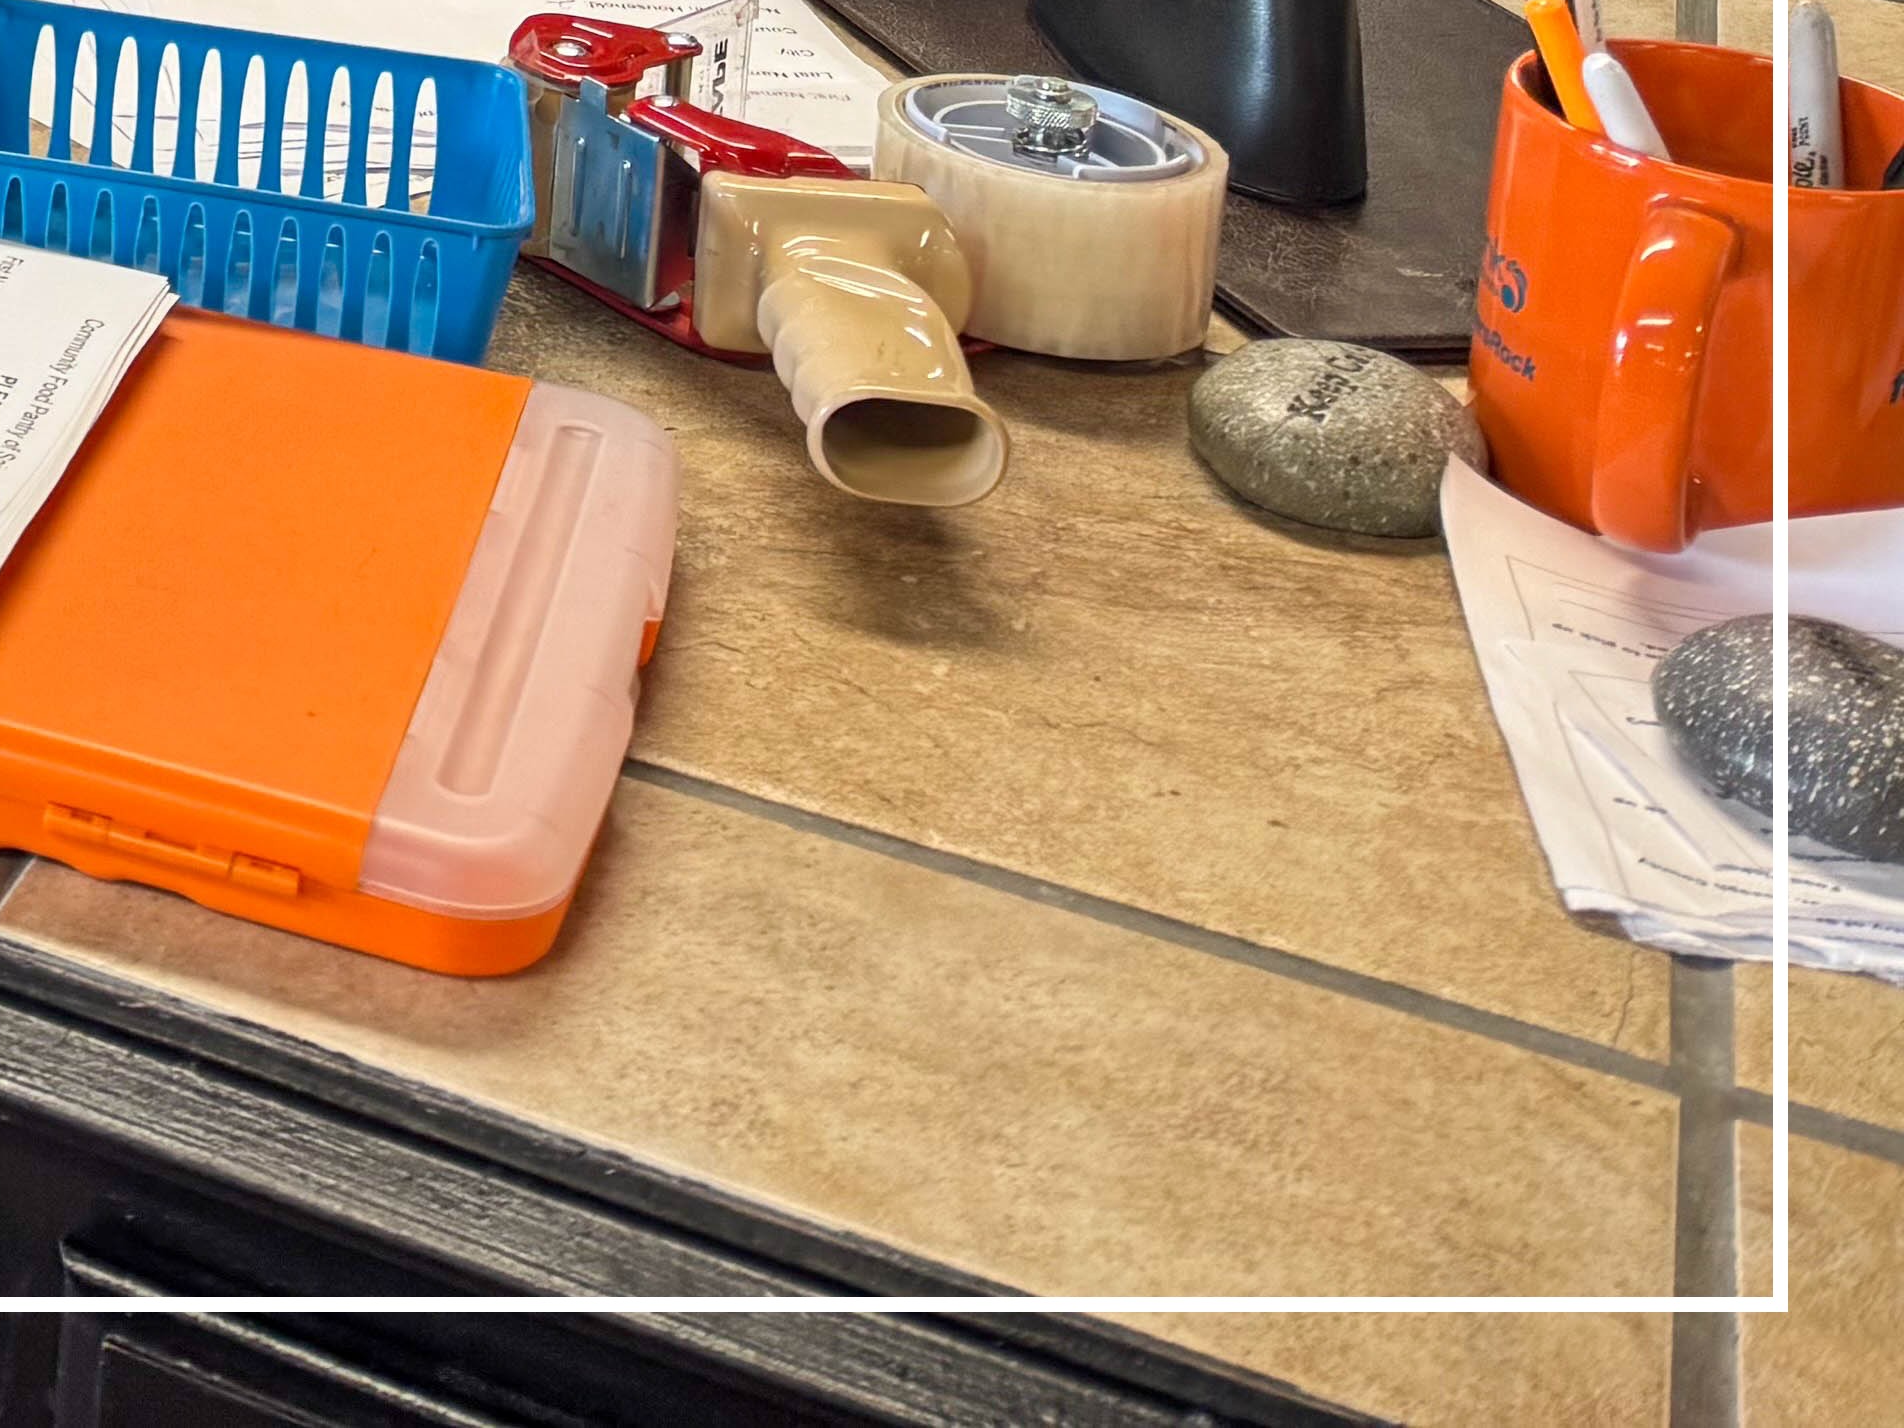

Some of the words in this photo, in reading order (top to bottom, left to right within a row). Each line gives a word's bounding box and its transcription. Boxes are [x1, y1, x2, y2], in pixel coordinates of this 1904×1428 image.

[48, 317, 106, 377] Community
[34, 374, 70, 405] Food
[13, 403, 50, 441] Pantry
[3, 437, 22, 454] of
